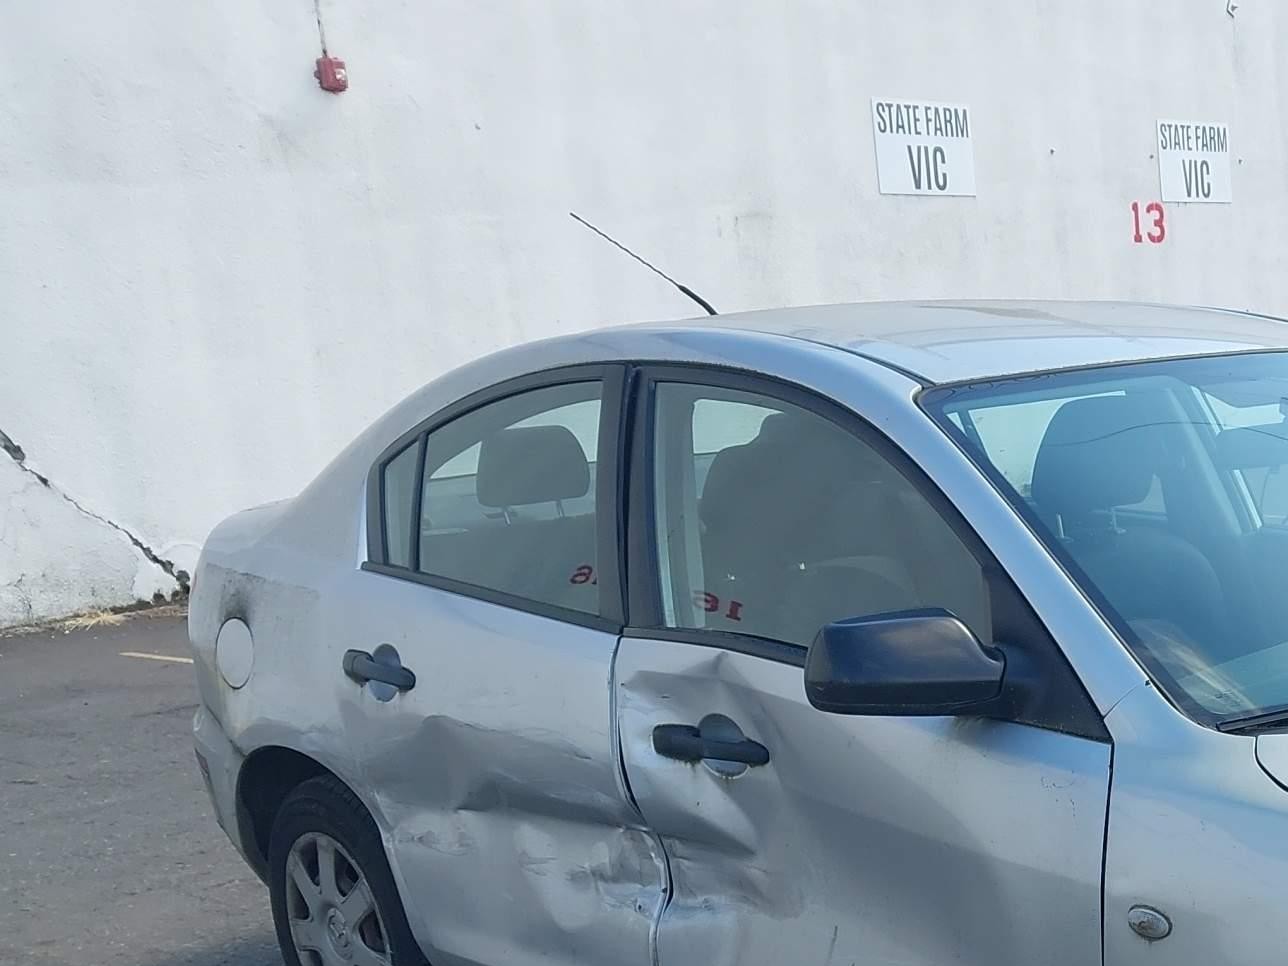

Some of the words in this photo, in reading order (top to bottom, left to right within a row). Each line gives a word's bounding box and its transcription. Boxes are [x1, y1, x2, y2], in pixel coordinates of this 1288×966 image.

[876, 102, 922, 136] STATE
[924, 106, 970, 139] FARM
[1159, 123, 1193, 151] STATE
[1195, 125, 1228, 153] FARM
[906, 145, 948, 191] VIC
[1182, 158, 1212, 199] VIC
[1131, 201, 1166, 244] 13
